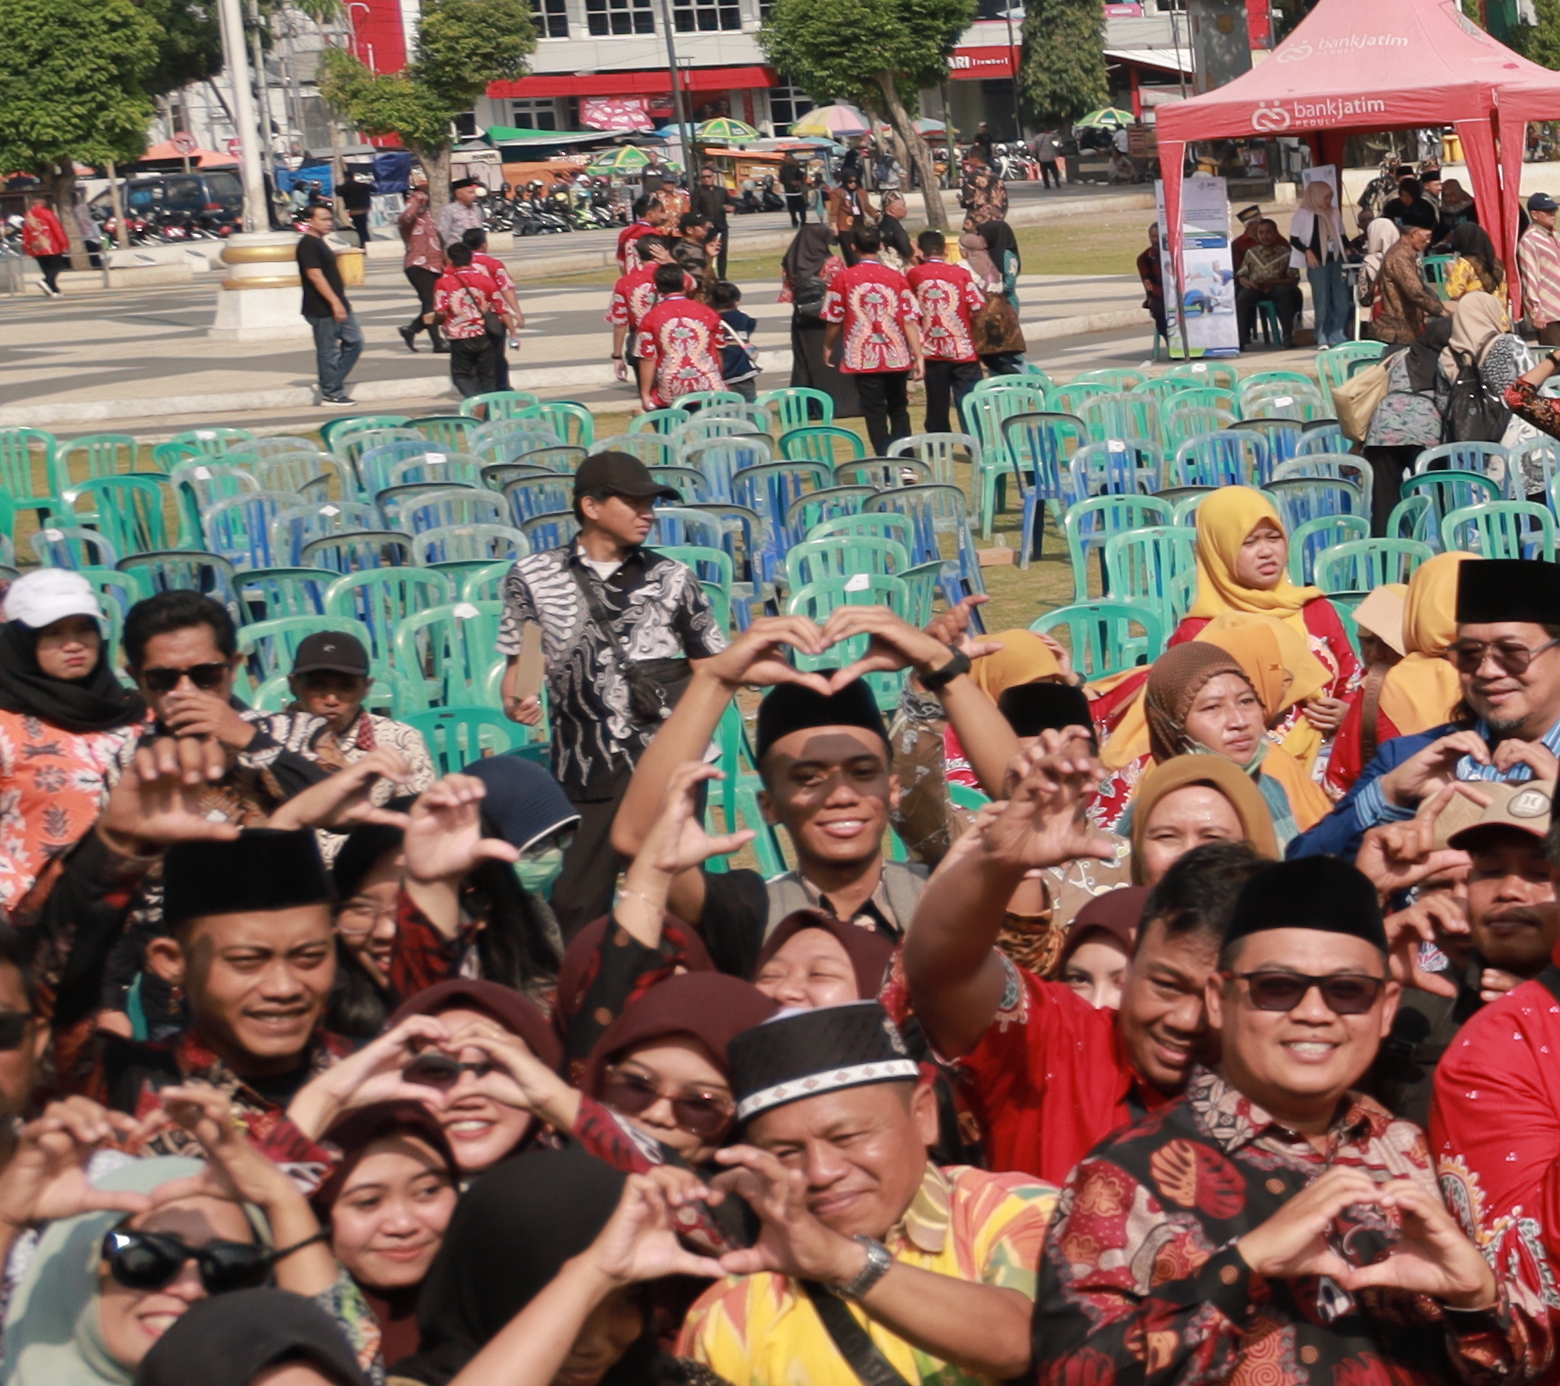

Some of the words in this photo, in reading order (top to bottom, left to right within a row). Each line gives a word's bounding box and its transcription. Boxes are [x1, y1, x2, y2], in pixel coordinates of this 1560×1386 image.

[1317, 33, 1409, 50] bankjatim
[1293, 97, 1386, 120] bankjatim
[1295, 118, 1336, 128] PEDULI
